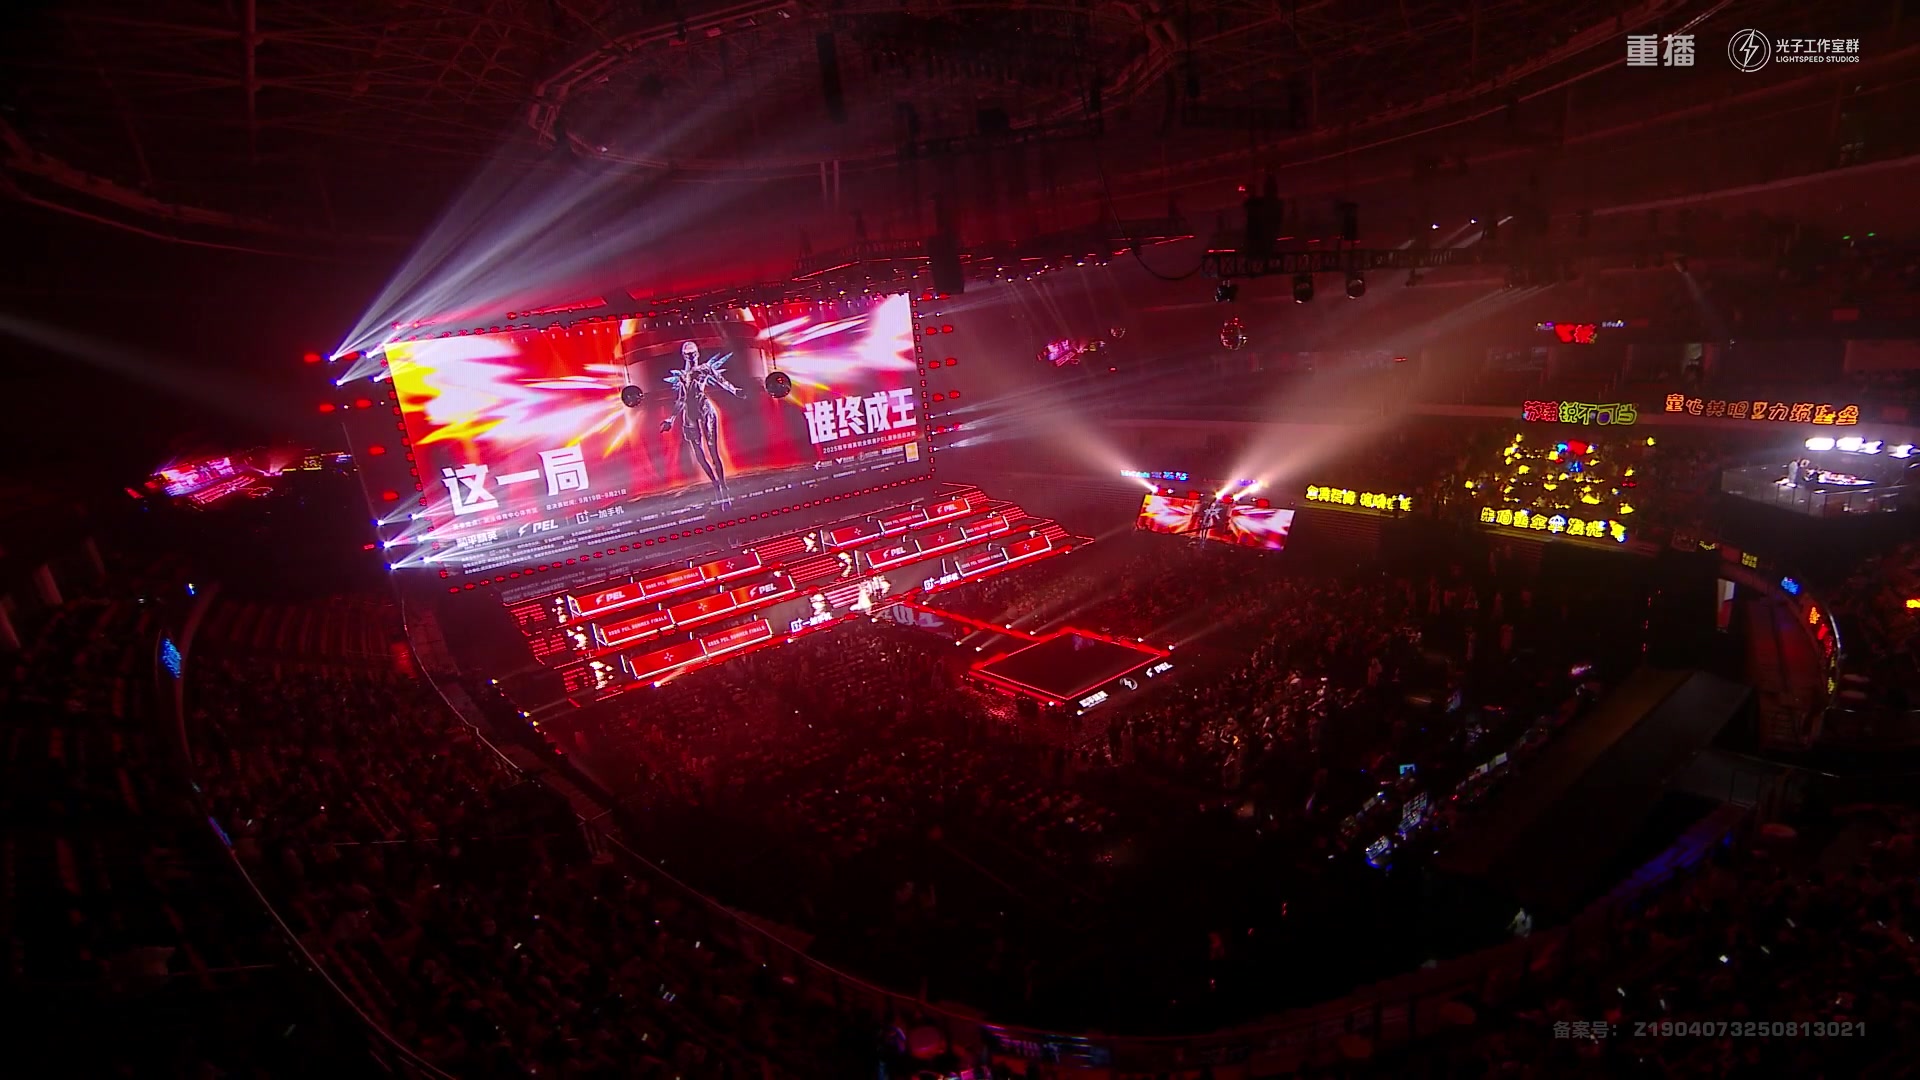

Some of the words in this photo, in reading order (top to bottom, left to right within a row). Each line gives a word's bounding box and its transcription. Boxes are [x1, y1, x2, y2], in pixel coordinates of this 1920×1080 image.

[803, 387, 917, 444] 谁终成王
[440, 444, 590, 516] 这一局
[589, 505, 625, 520] 一加手机
[532, 519, 559, 534] PEL
[456, 530, 498, 548] 和平精英
[890, 546, 907, 557] PEL
[758, 582, 778, 594] PEL
[605, 590, 626, 602] PEL
[1153, 661, 1174, 674] PEL
